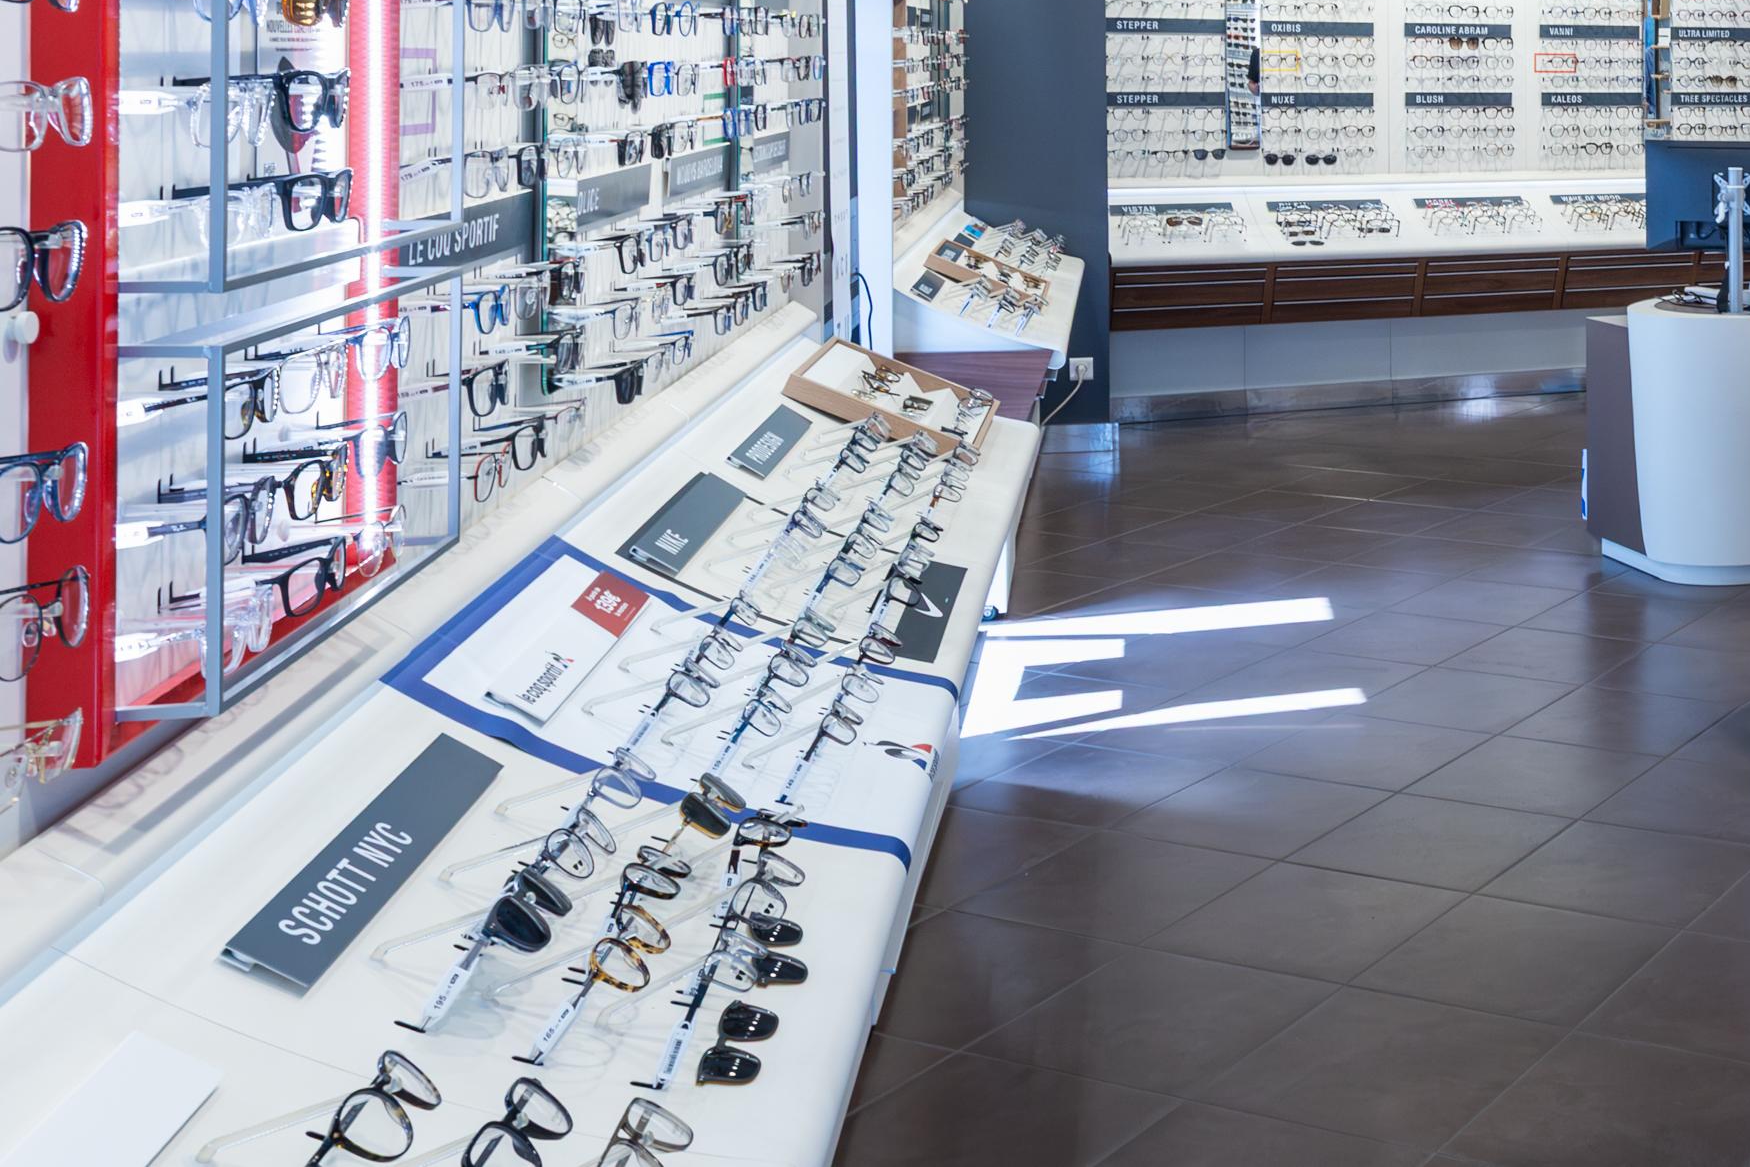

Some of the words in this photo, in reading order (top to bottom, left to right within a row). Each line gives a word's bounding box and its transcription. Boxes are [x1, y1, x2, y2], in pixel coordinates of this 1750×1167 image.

[1116, 20, 1159, 30] STEPPER
[1271, 23, 1301, 33] OXIBIS
[1415, 26, 1456, 35] CAROLINE
[1459, 26, 1488, 35] ABRAM
[1549, 27, 1574, 37] VANNI
[1678, 29, 1700, 38] ULTRA
[1702, 29, 1730, 39] LIMITED
[1116, 94, 1159, 104] STEPPER
[1271, 95, 1295, 104] NUXE
[1416, 95, 1444, 104] BLUSH
[1551, 95, 1582, 104] KALEOS
[1680, 95, 1699, 103] TREE
[1701, 94, 1748, 104] SPECTACLES
[408, 241, 423, 265] LE
[454, 213, 500, 253] SPORTIF
[655, 529, 689, 556] NIKE
[278, 857, 377, 945] SCHOTT
[352, 822, 413, 868] NYC
